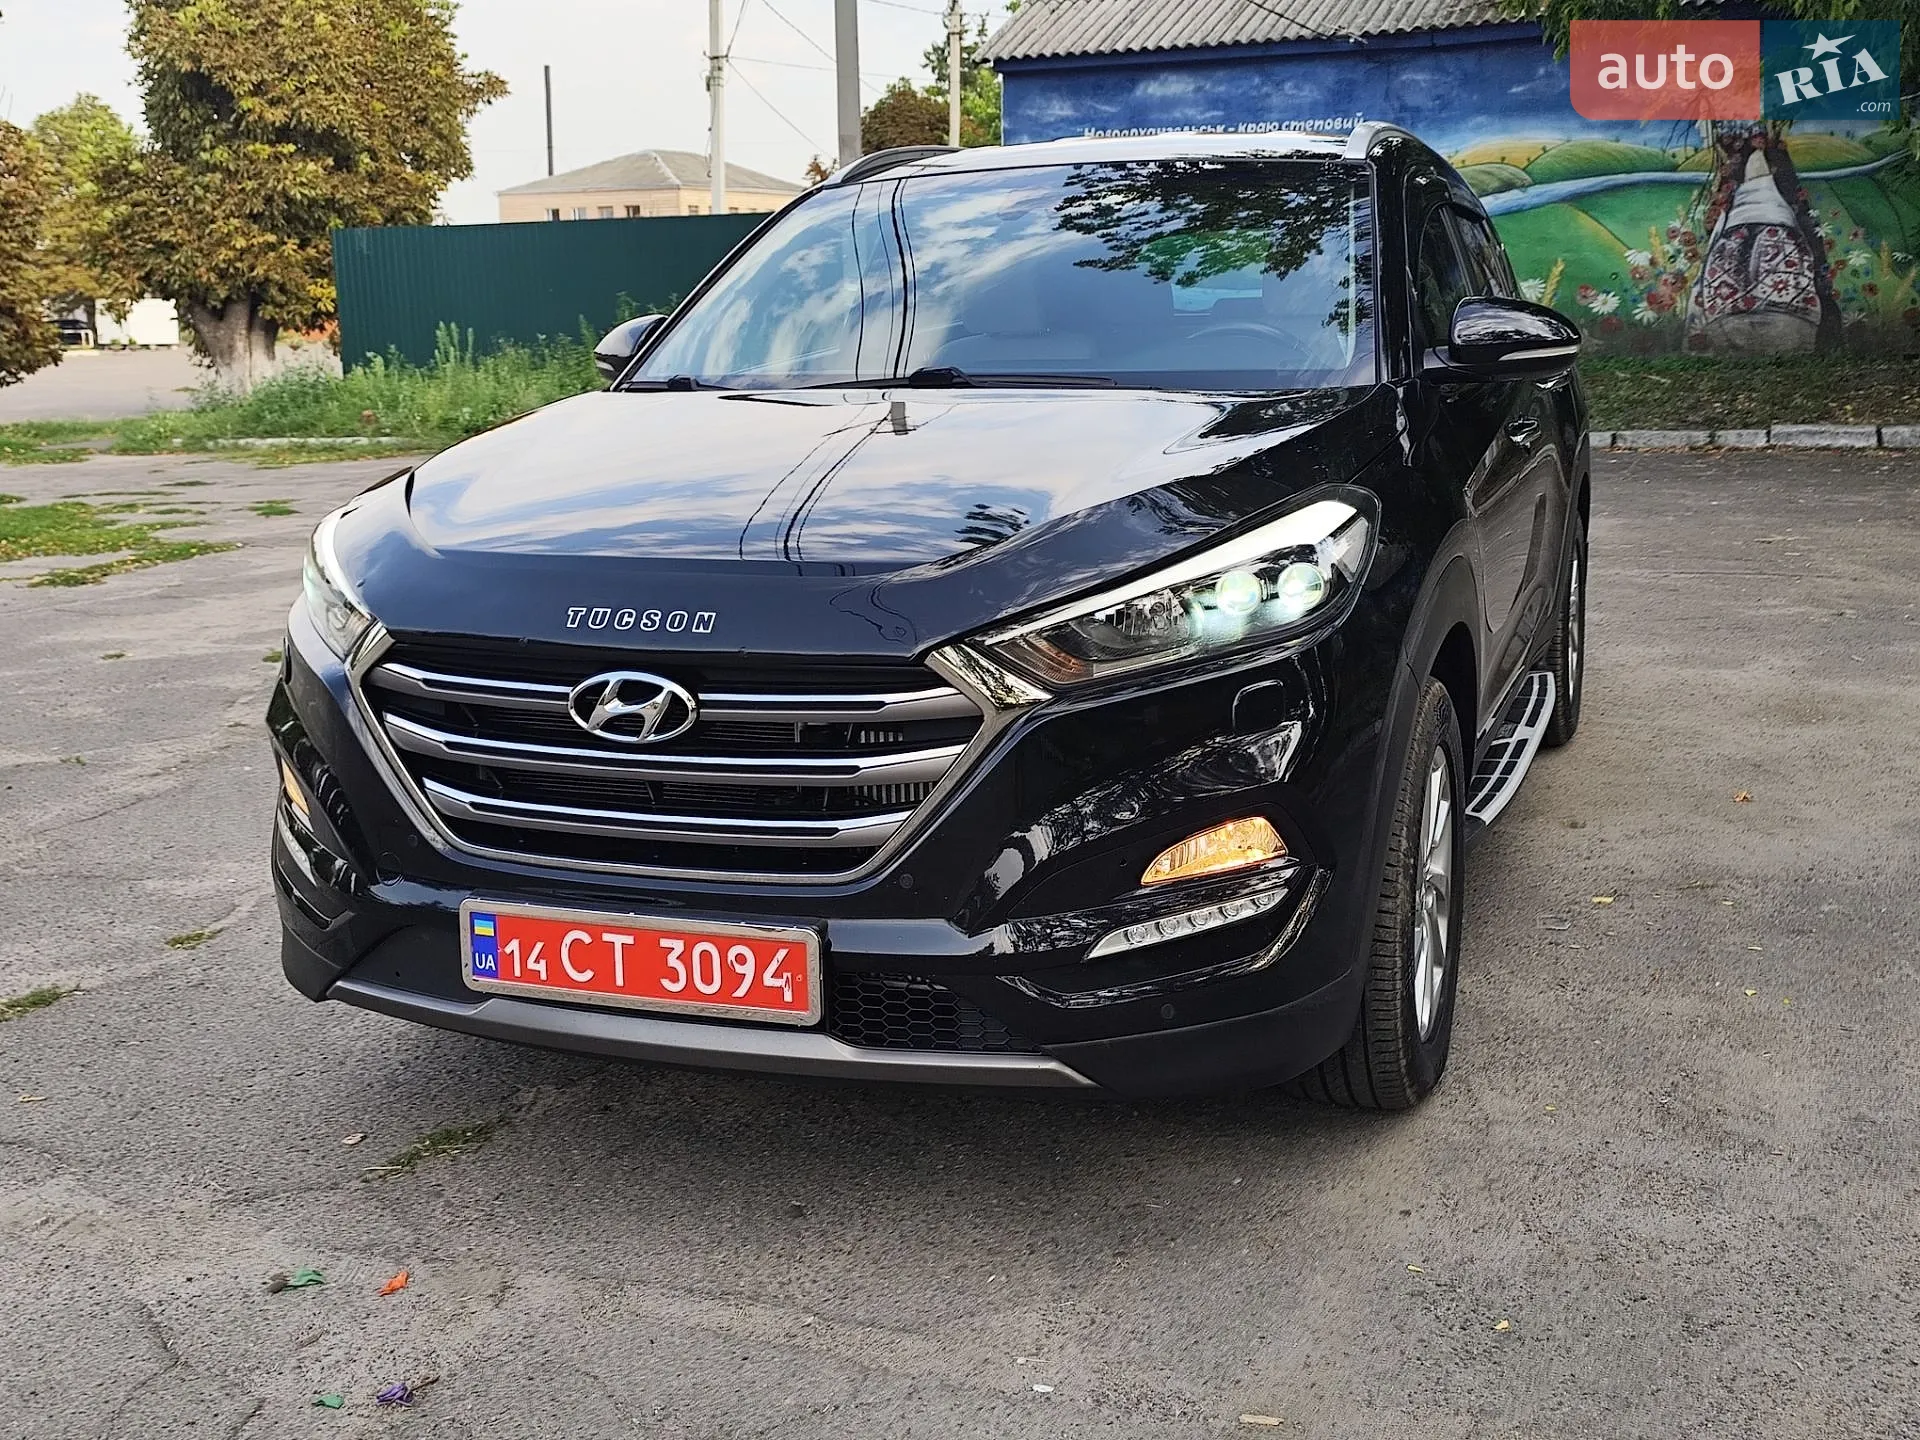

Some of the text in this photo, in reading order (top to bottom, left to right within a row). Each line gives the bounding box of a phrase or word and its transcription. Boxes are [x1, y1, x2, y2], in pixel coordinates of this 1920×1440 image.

[1280, 112, 1364, 131] степовий
[566, 607, 717, 633] TUCSON
[475, 952, 496, 971] UA
[503, 929, 793, 1002] 14 CT 3094
